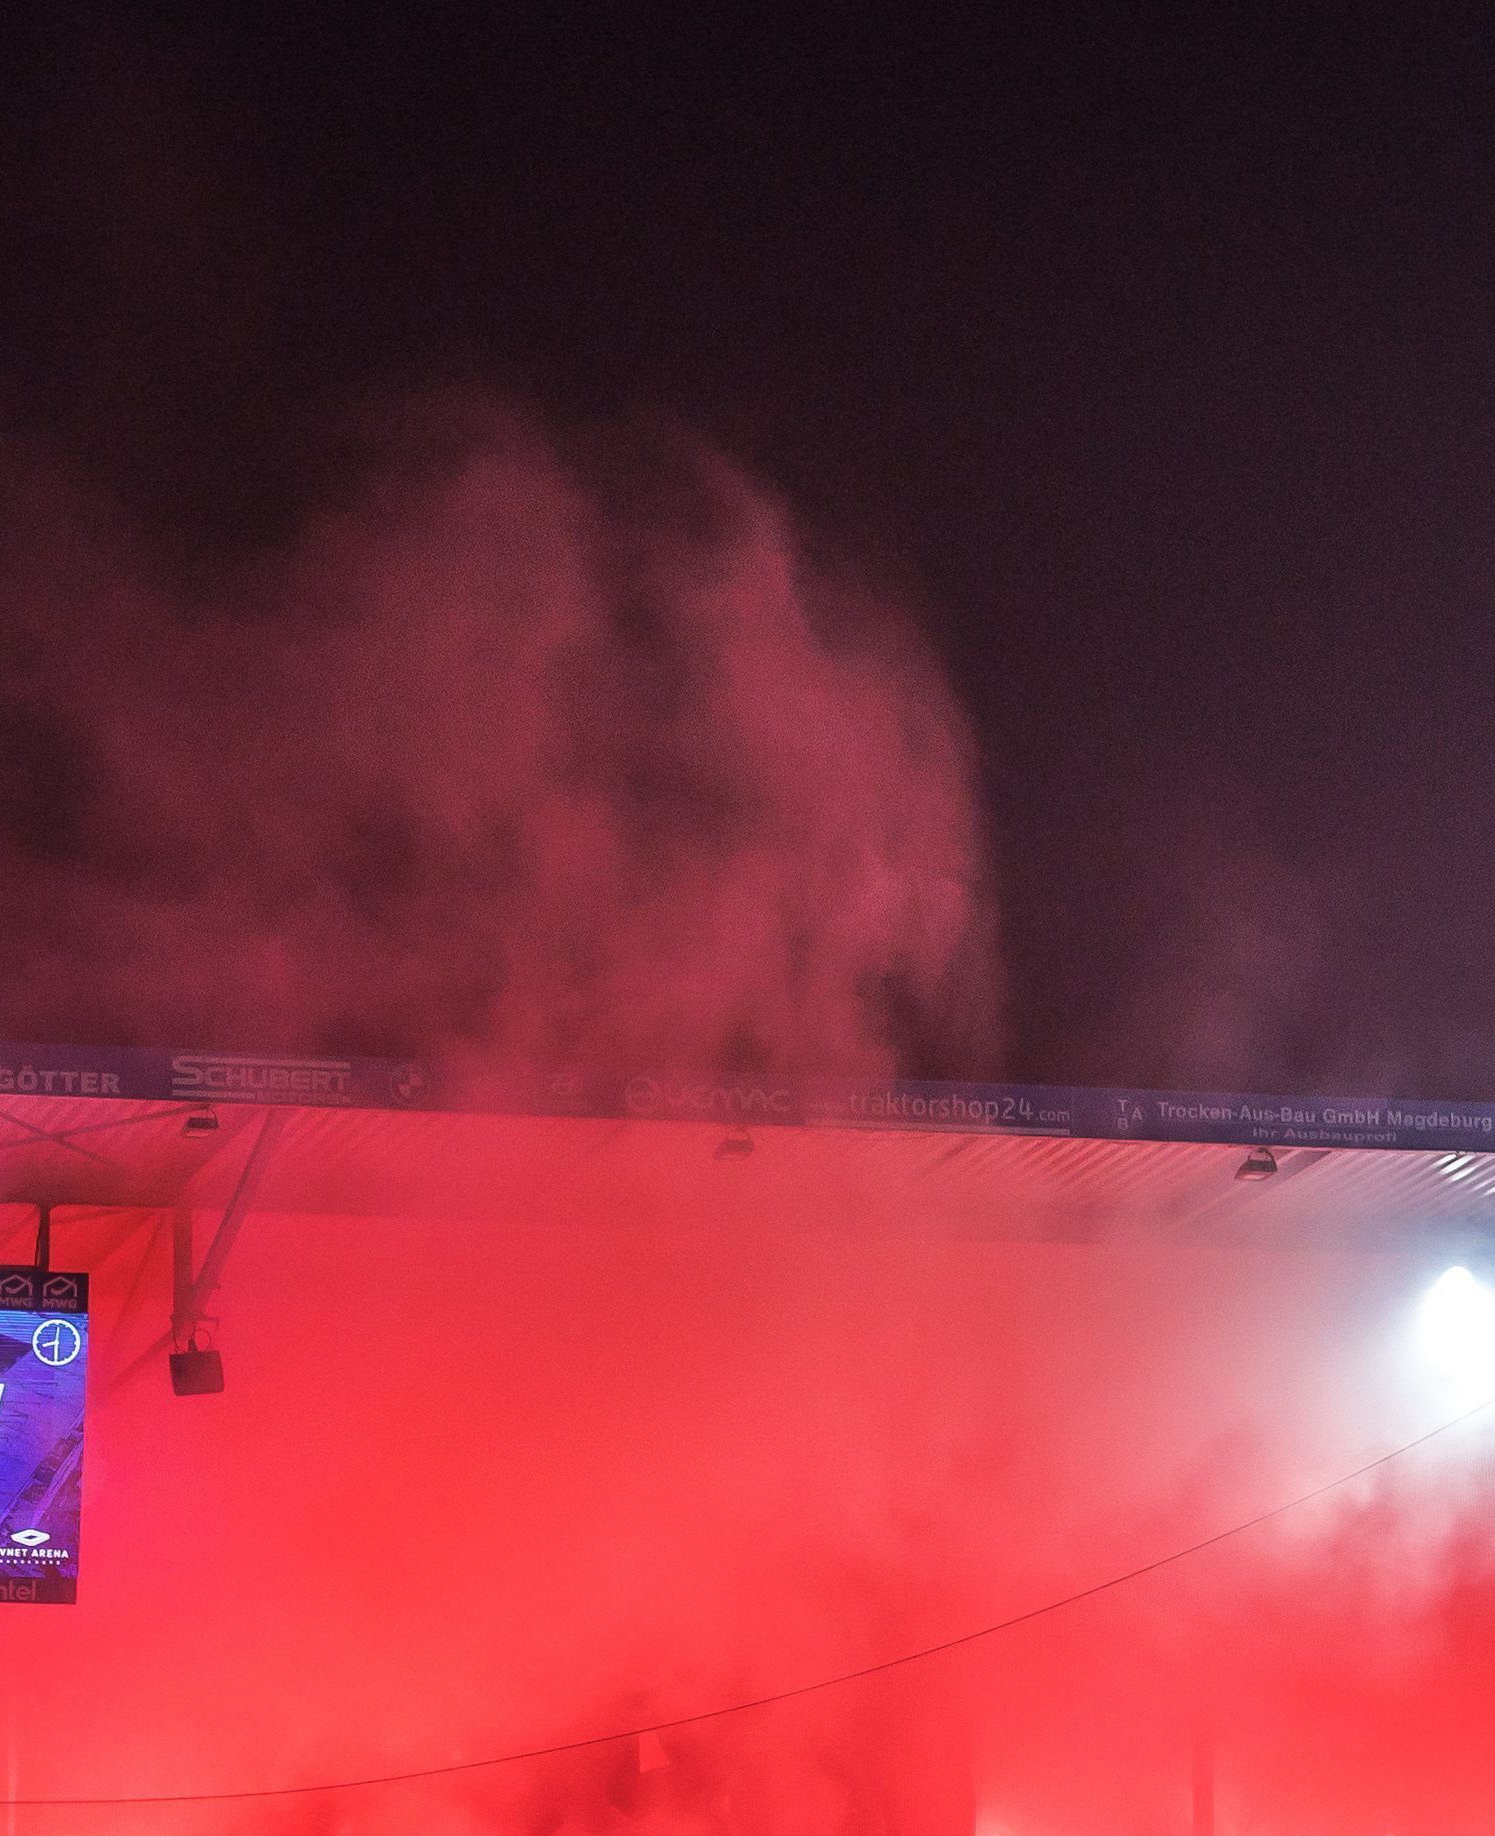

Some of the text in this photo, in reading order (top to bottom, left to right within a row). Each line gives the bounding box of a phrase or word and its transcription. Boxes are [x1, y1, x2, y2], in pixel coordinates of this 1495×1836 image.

[1322, 1105, 1380, 1126] GmbH
[1387, 1109, 1493, 1132] Magdeburg
[43, 1297, 79, 1309] MWG
[31, 1548, 69, 1559] ARENA
